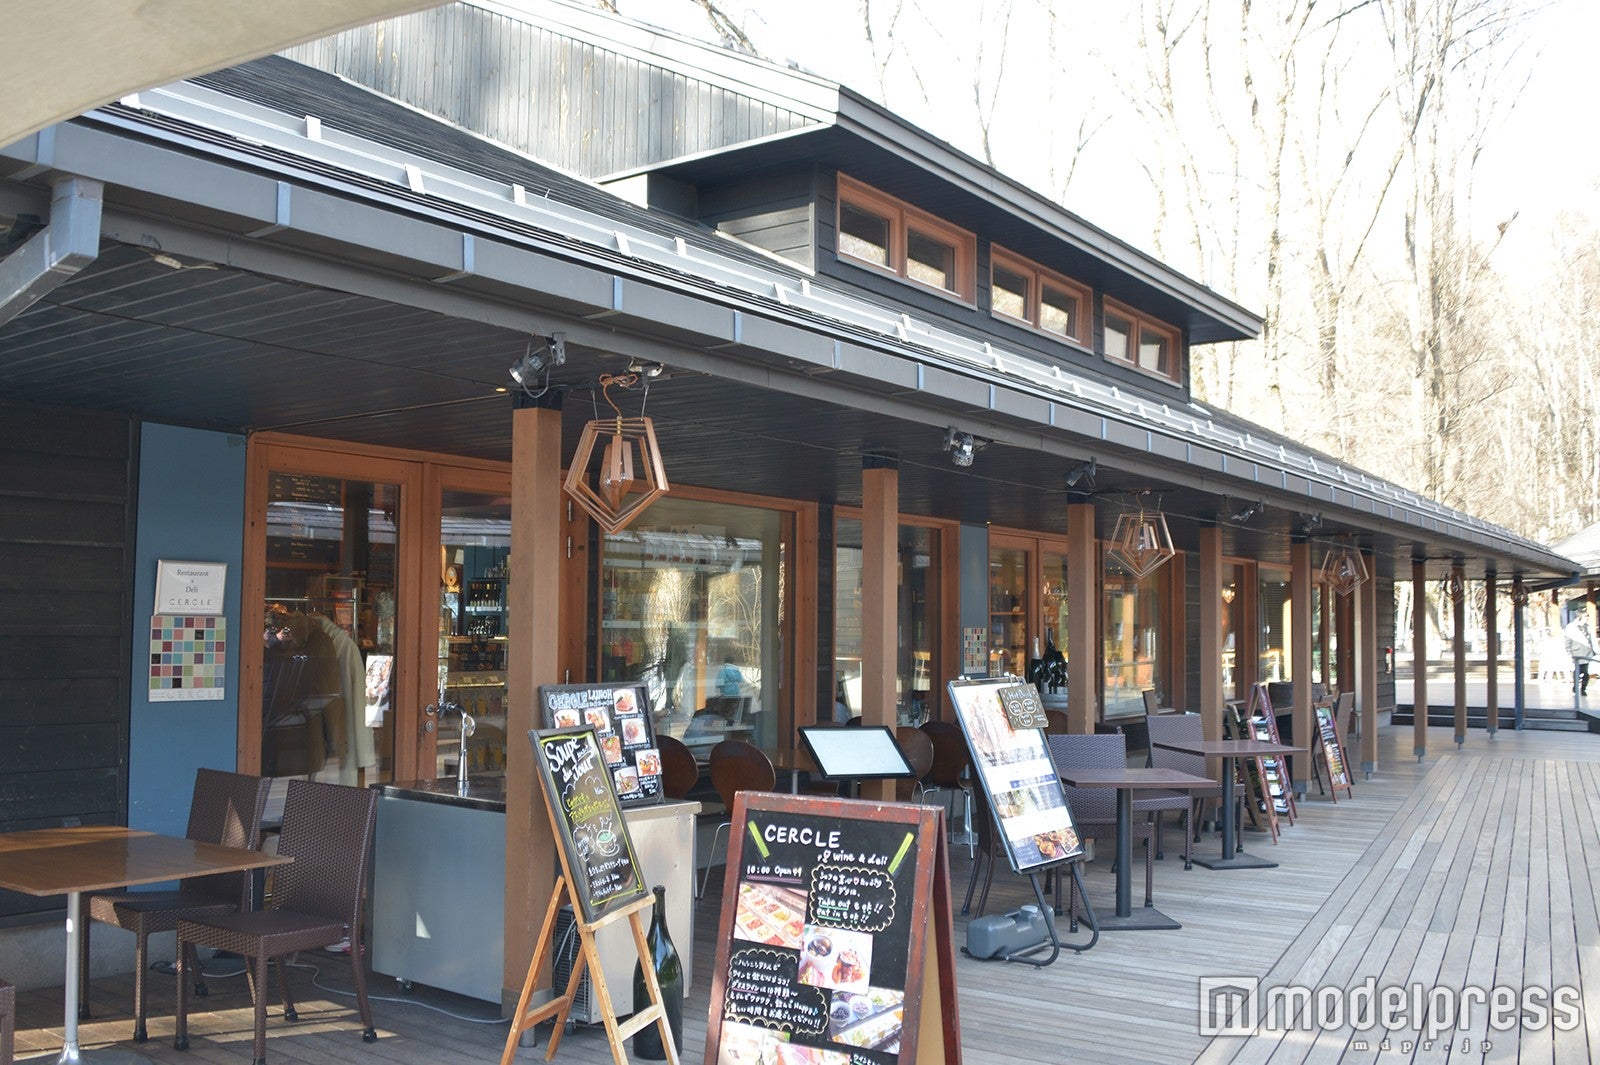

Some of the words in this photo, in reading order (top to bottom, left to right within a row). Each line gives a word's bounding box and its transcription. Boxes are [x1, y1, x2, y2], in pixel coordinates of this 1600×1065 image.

[176, 569, 209, 577] Restaurant
[185, 586, 199, 594] Deli
[169, 598, 212, 606] CERCLE
[587, 688, 613, 700] LUNCH
[545, 737, 580, 773] Soupe
[562, 766, 573, 783] du
[571, 753, 595, 782] Jour
[764, 824, 841, 849] CERCLE
[832, 849, 855, 862] wine
[867, 853, 888, 866] deli
[774, 865, 792, 878] Open
[817, 896, 836, 908] Take
[832, 909, 841, 918] in
